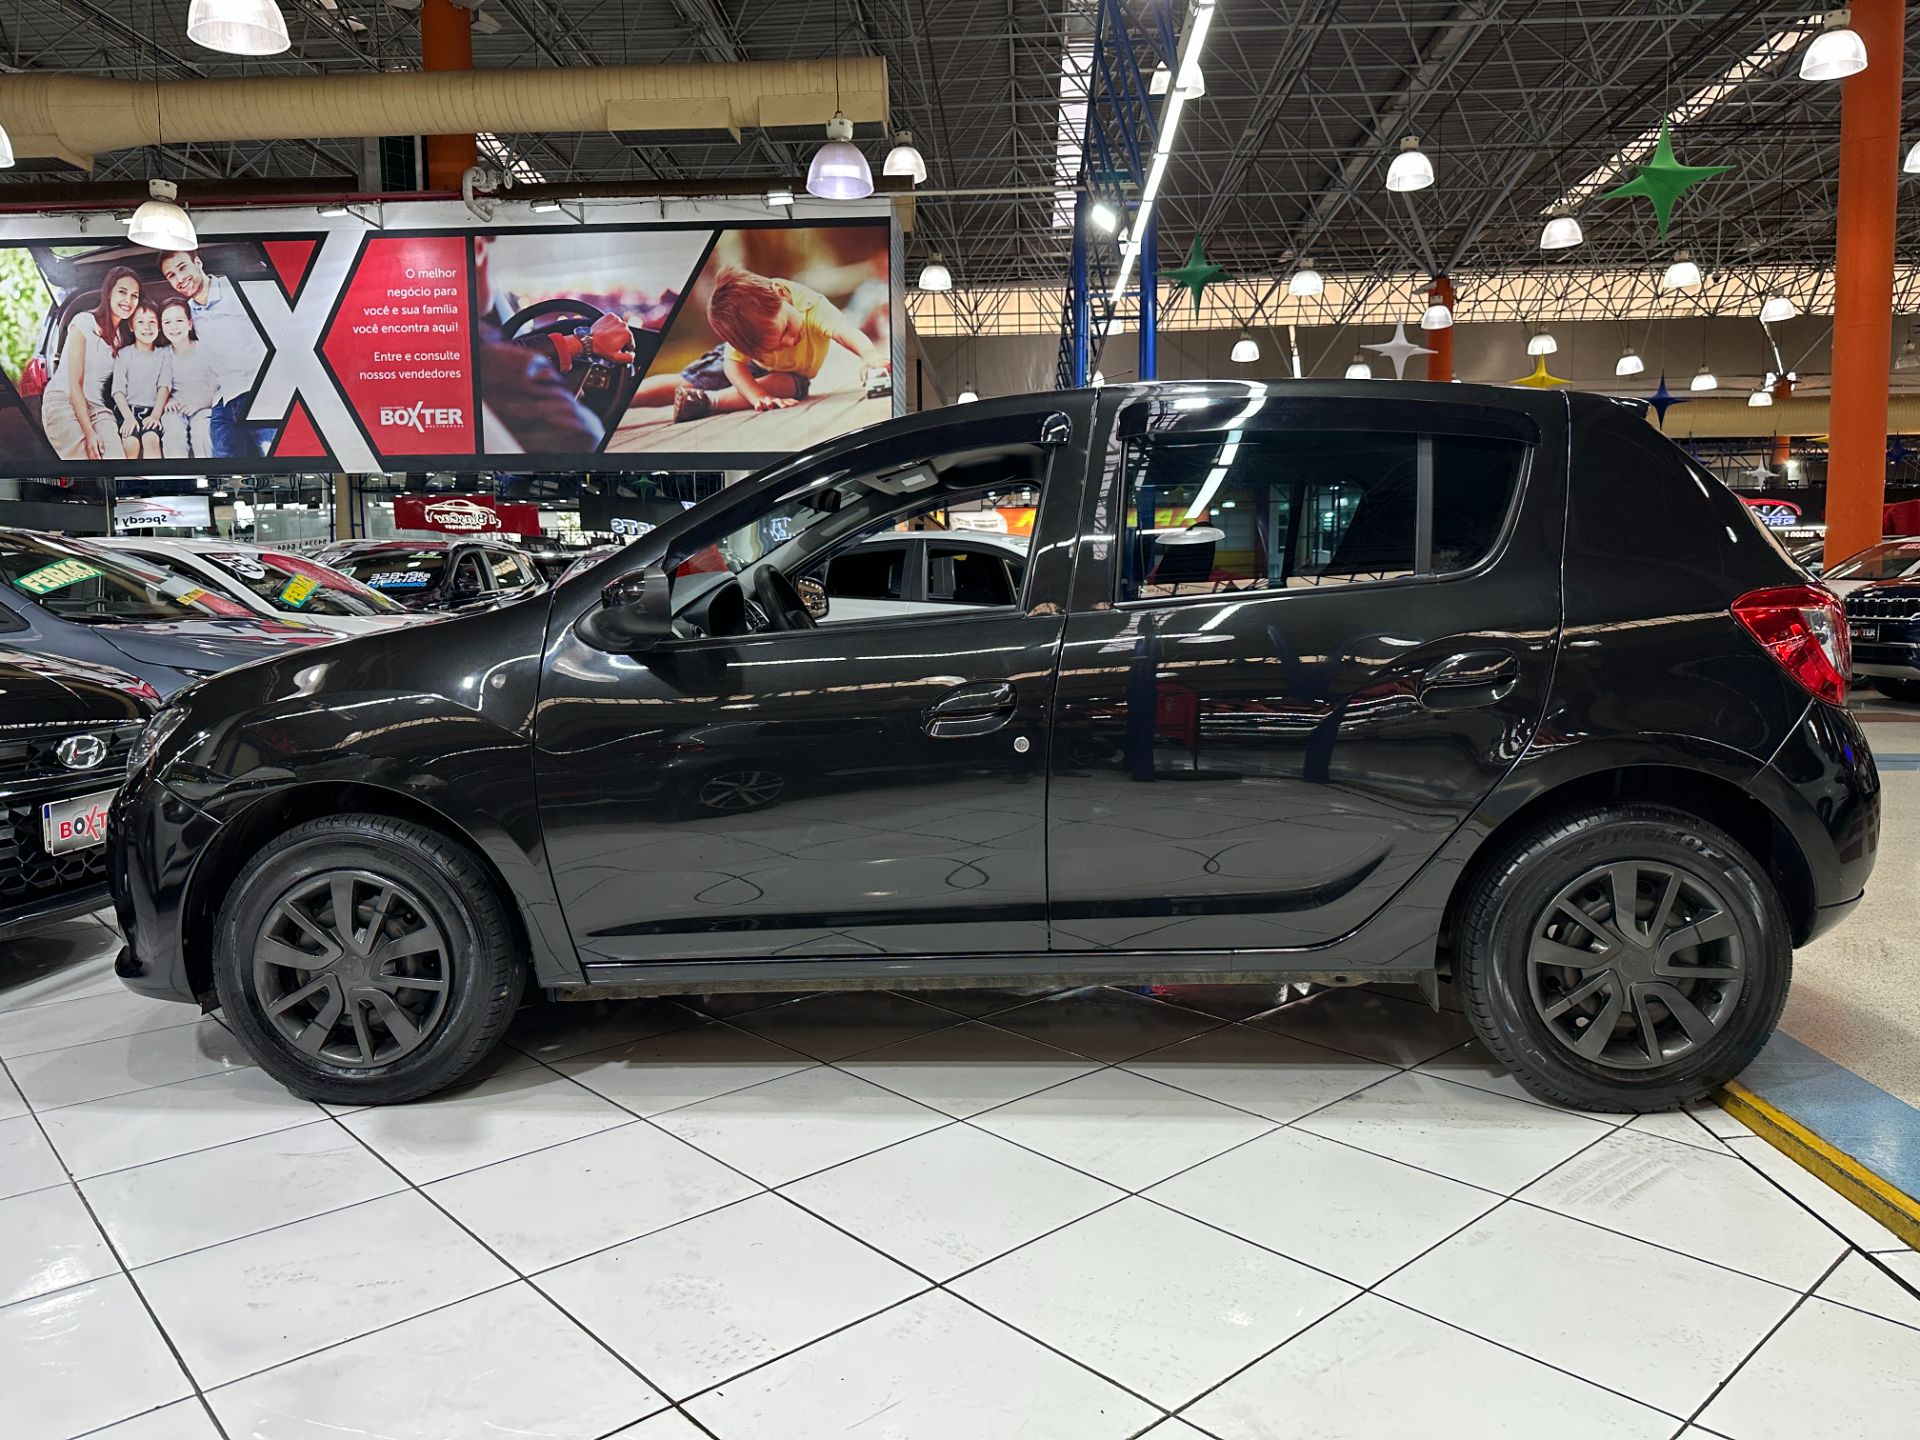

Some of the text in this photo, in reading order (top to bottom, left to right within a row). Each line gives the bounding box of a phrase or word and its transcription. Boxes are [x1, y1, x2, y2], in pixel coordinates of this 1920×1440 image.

[405, 268, 456, 279] O melhor
[387, 287, 458, 299] negócio para
[363, 304, 458, 316] você e sua família
[352, 322, 459, 336] você encontra aqui!
[374, 351, 461, 362] Entre e consulte
[359, 369, 462, 380] nossos vendedores
[380, 401, 464, 433] BOXTER
